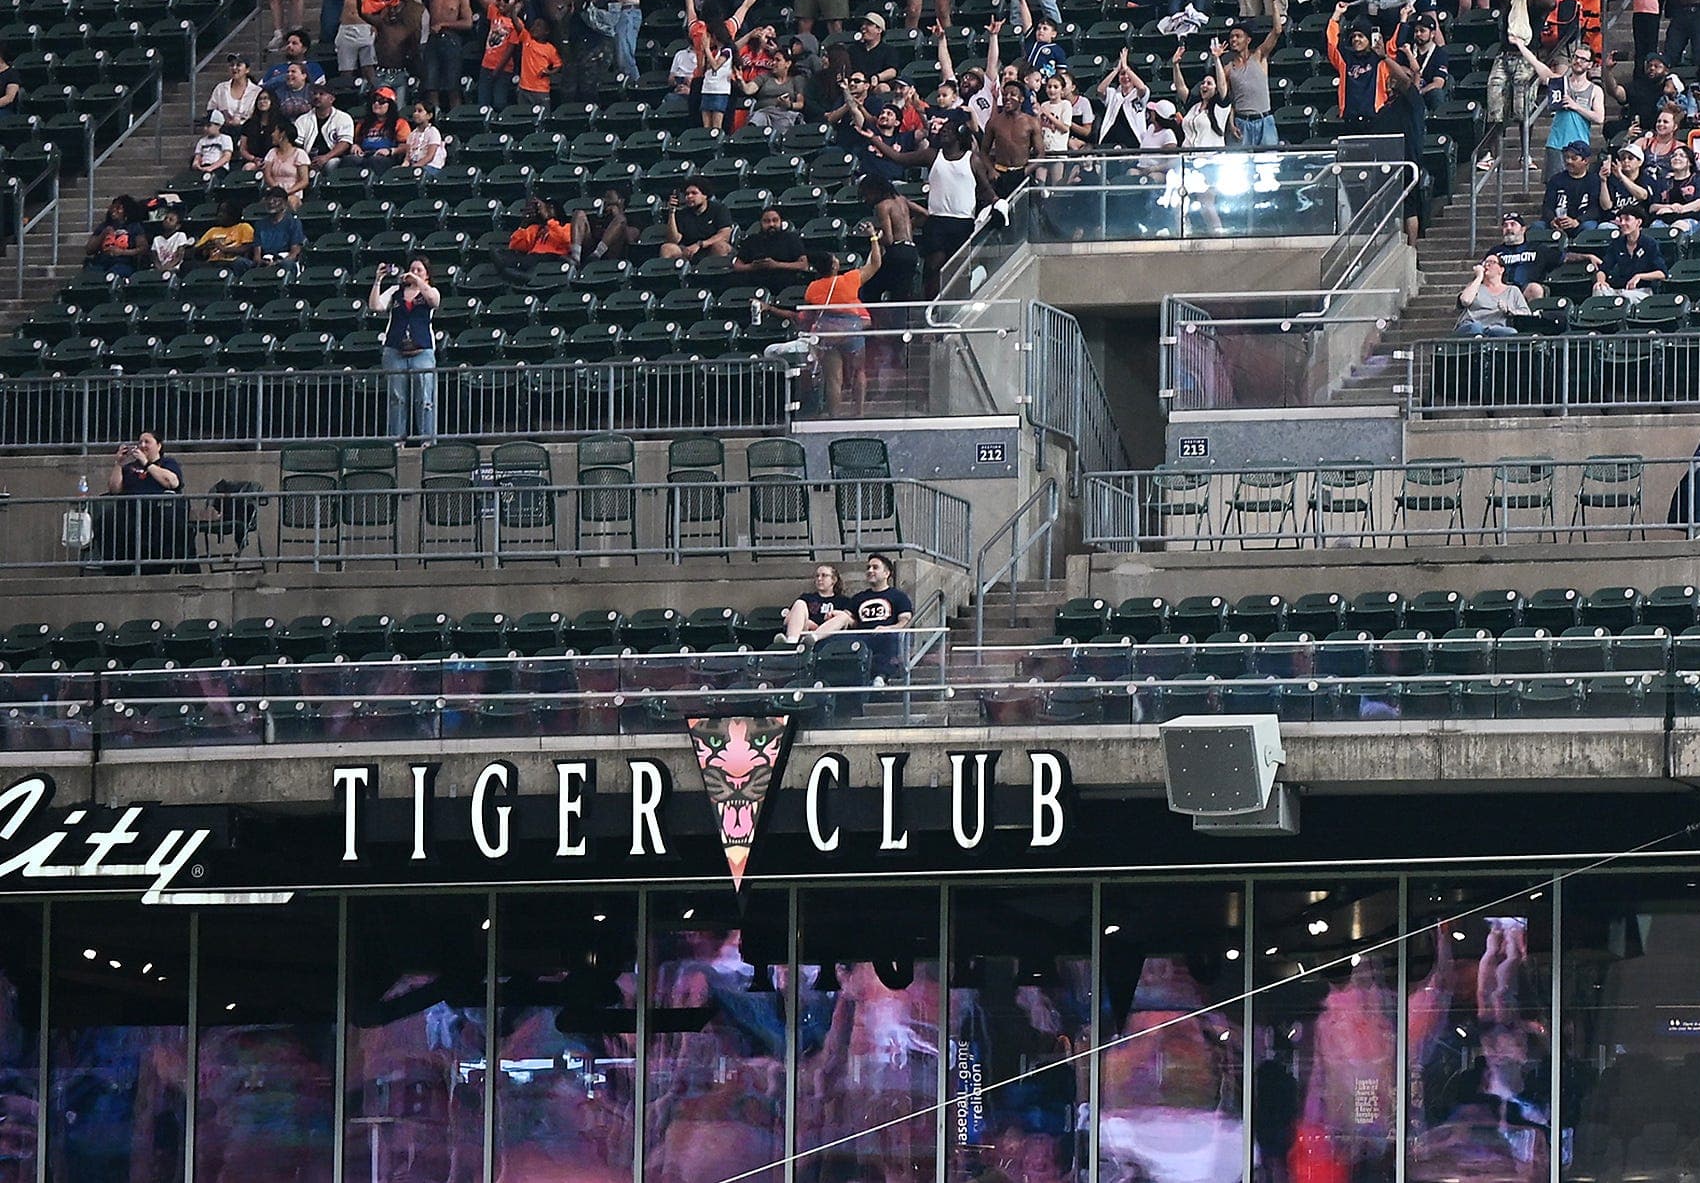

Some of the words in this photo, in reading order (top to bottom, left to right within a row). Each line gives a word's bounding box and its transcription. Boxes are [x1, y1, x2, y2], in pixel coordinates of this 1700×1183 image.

[980, 449, 1002, 461] 212
[1183, 444, 1205, 456] 213
[861, 606, 885, 618] 313
[333, 761, 666, 861] TIGER
[806, 753, 1065, 852] CLUB
